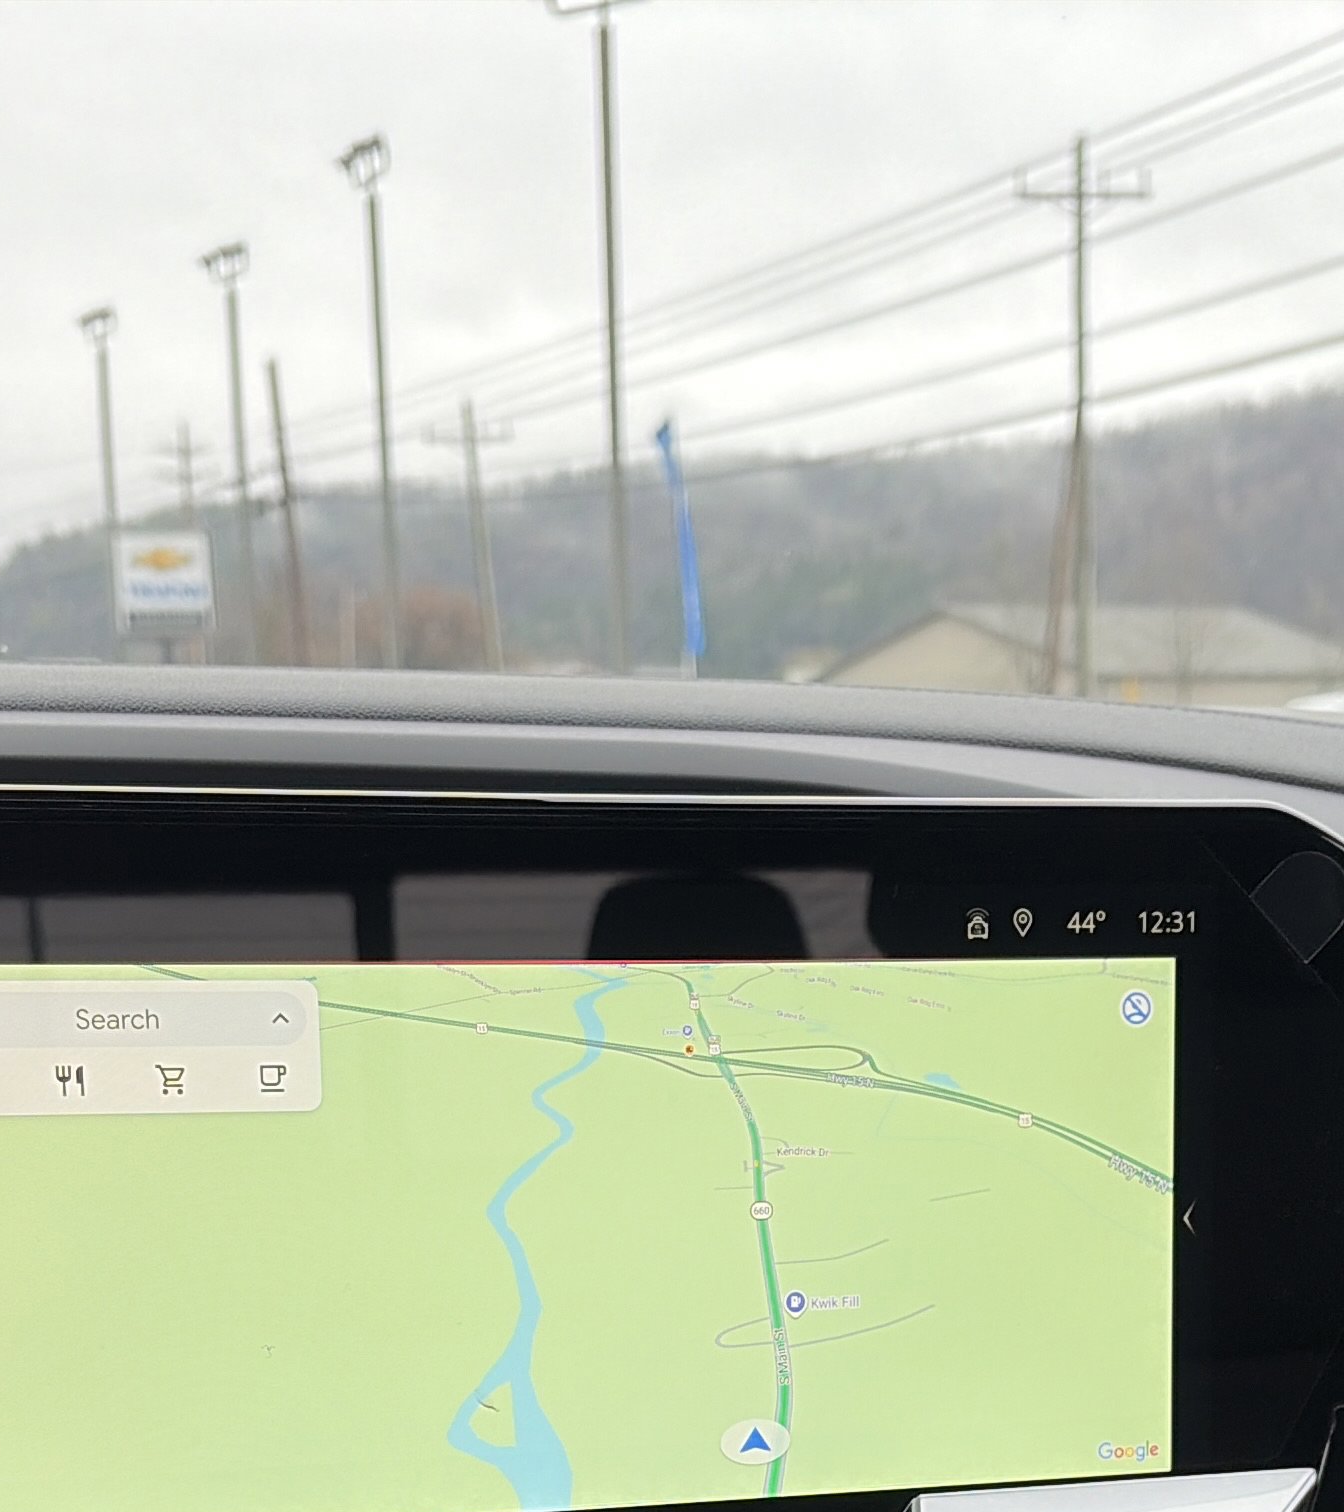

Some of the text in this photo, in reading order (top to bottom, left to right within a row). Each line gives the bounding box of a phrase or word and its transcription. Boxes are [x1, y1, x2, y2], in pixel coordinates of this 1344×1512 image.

[1066, 910, 1106, 934] 44°
[1137, 910, 1196, 934] 12:31
[75, 1008, 160, 1030] Search
[776, 1147, 830, 1157] Kendrick Dr
[1108, 1155, 1137, 1181] Hwy
[753, 1206, 770, 1216] 660
[811, 1296, 860, 1309] Kwik Fill
[774, 1328, 784, 1342] St
[777, 1343, 789, 1376] Main
[1097, 1439, 1160, 1462] Google
